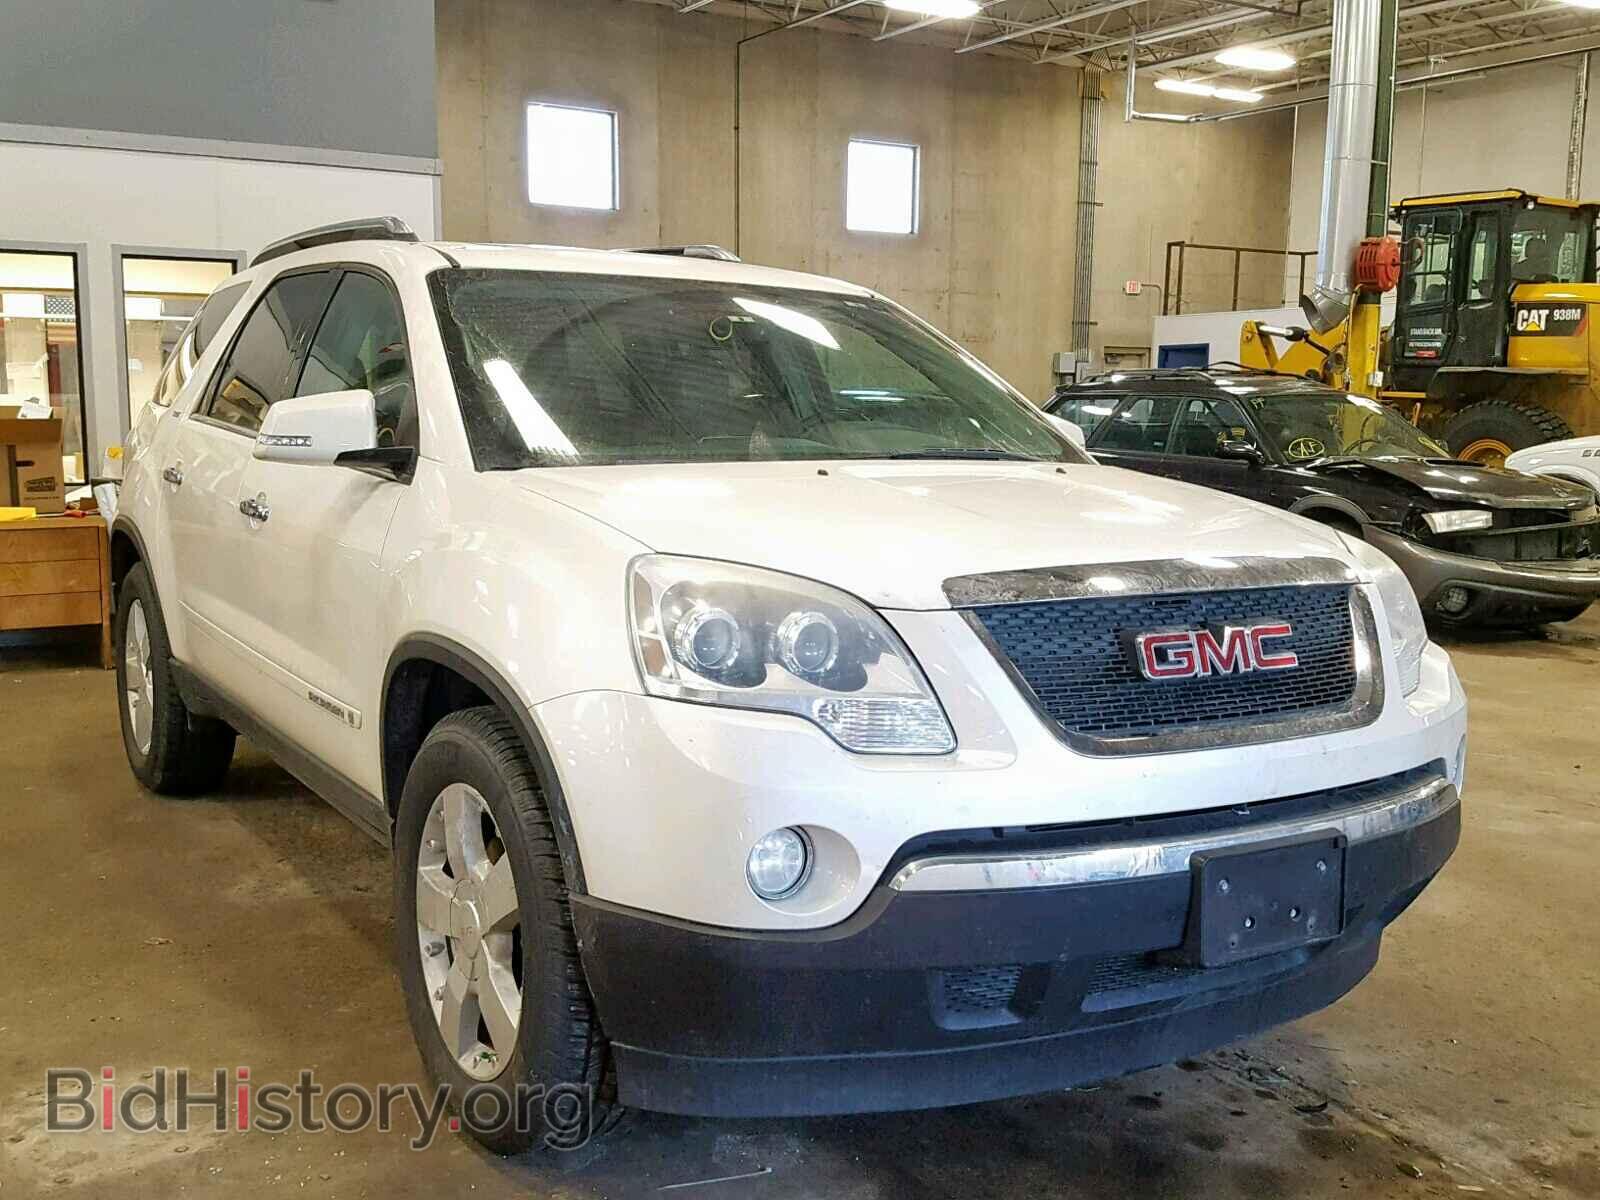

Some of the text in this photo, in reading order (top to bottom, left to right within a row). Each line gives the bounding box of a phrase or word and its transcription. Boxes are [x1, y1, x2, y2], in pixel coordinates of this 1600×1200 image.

[1517, 308, 1582, 331] CAT 938M
[1135, 623, 1299, 680] GMC
